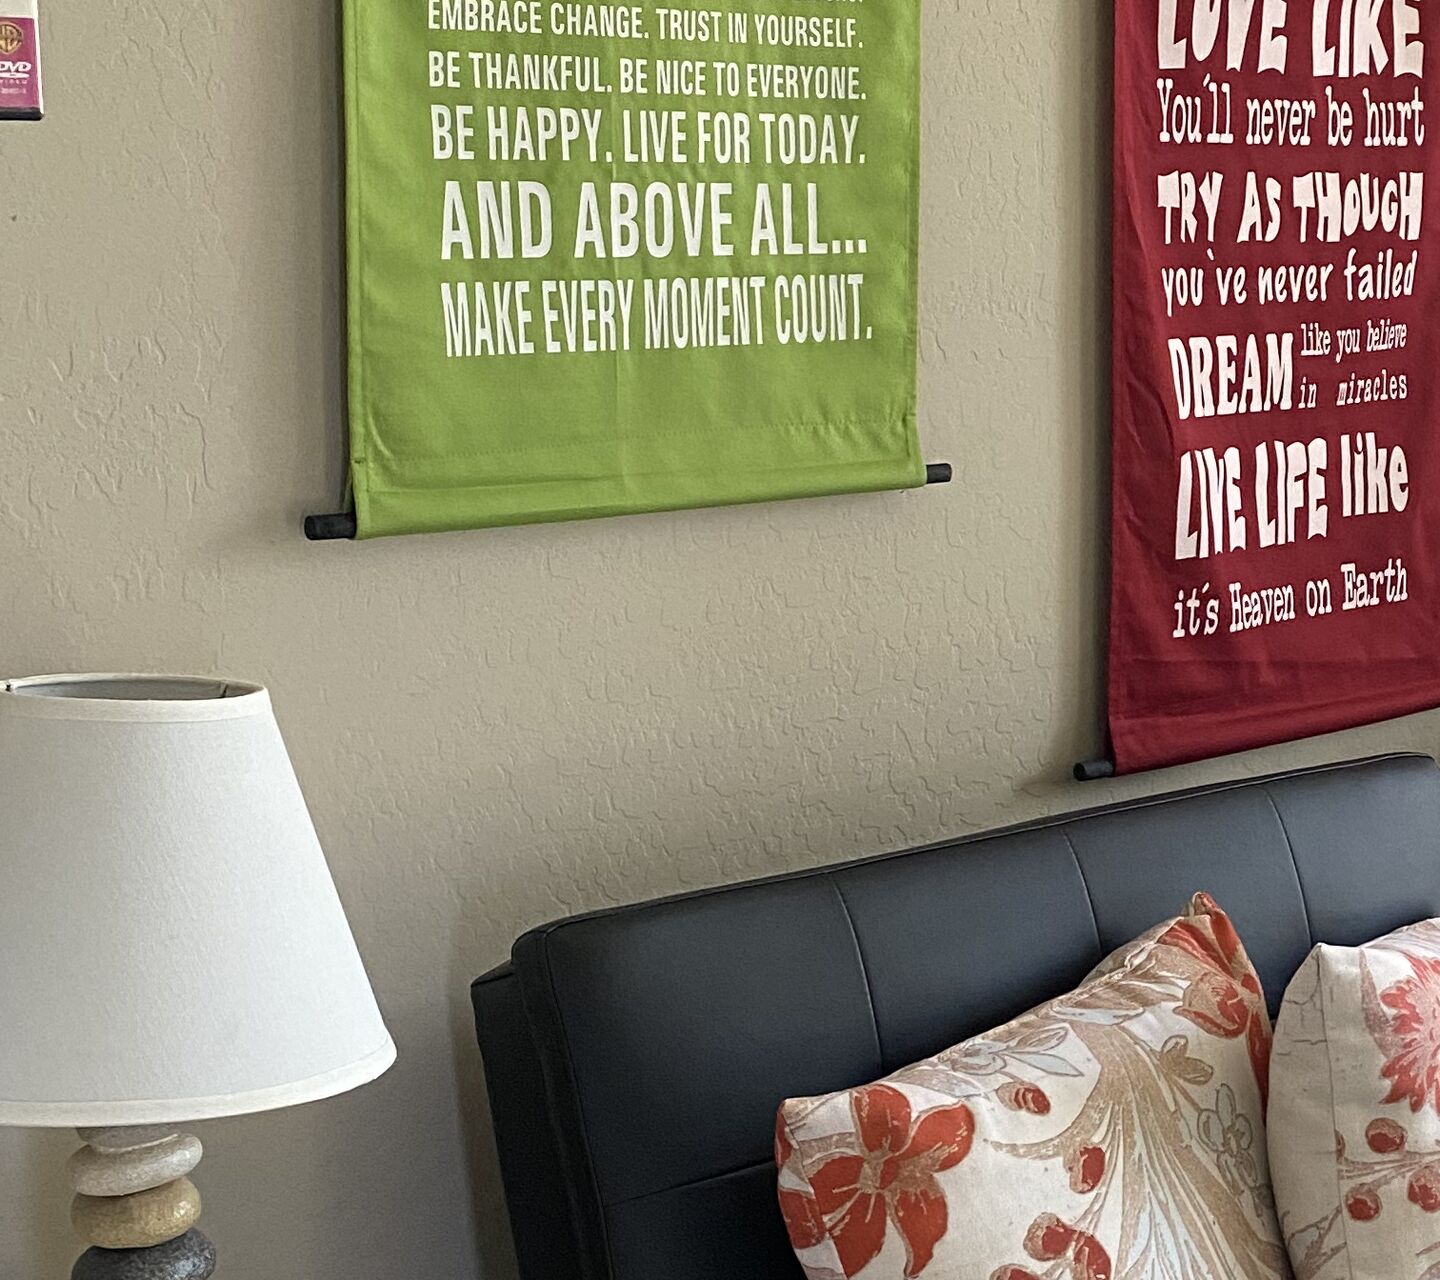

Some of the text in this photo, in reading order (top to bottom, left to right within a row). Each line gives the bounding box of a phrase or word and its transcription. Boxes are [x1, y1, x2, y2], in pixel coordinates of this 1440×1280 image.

[551, 3, 648, 38] CHANGE.
[656, 9, 721, 41] TRUST
[728, 13, 746, 43] IN
[755, 15, 863, 48] YOURSELF.
[0, 60, 32, 73] DVD
[431, 105, 864, 164] BE HAPPY. LIVE FOR TODAY.
[1246, 99, 1315, 145] never
[1325, 86, 1352, 146] be
[1363, 87, 1424, 146] hurt
[441, 181, 867, 259] AND ABOVE ALL...
[1158, 171, 1423, 245] TRY AS THOUGH
[1258, 264, 1333, 304] never
[1344, 248, 1417, 301] failed
[441, 274, 871, 357] MAKE EVERY MOMENT COUNT.
[1301, 319, 1406, 363] like you believe
[1168, 333, 1293, 419] DREAM
[1299, 369, 1407, 408] in miracles
[1176, 432, 1408, 559] LIVE LIFE like
[1229, 582, 1295, 632] Heaven
[1306, 579, 1332, 616] on
[1341, 559, 1407, 610] Earth
